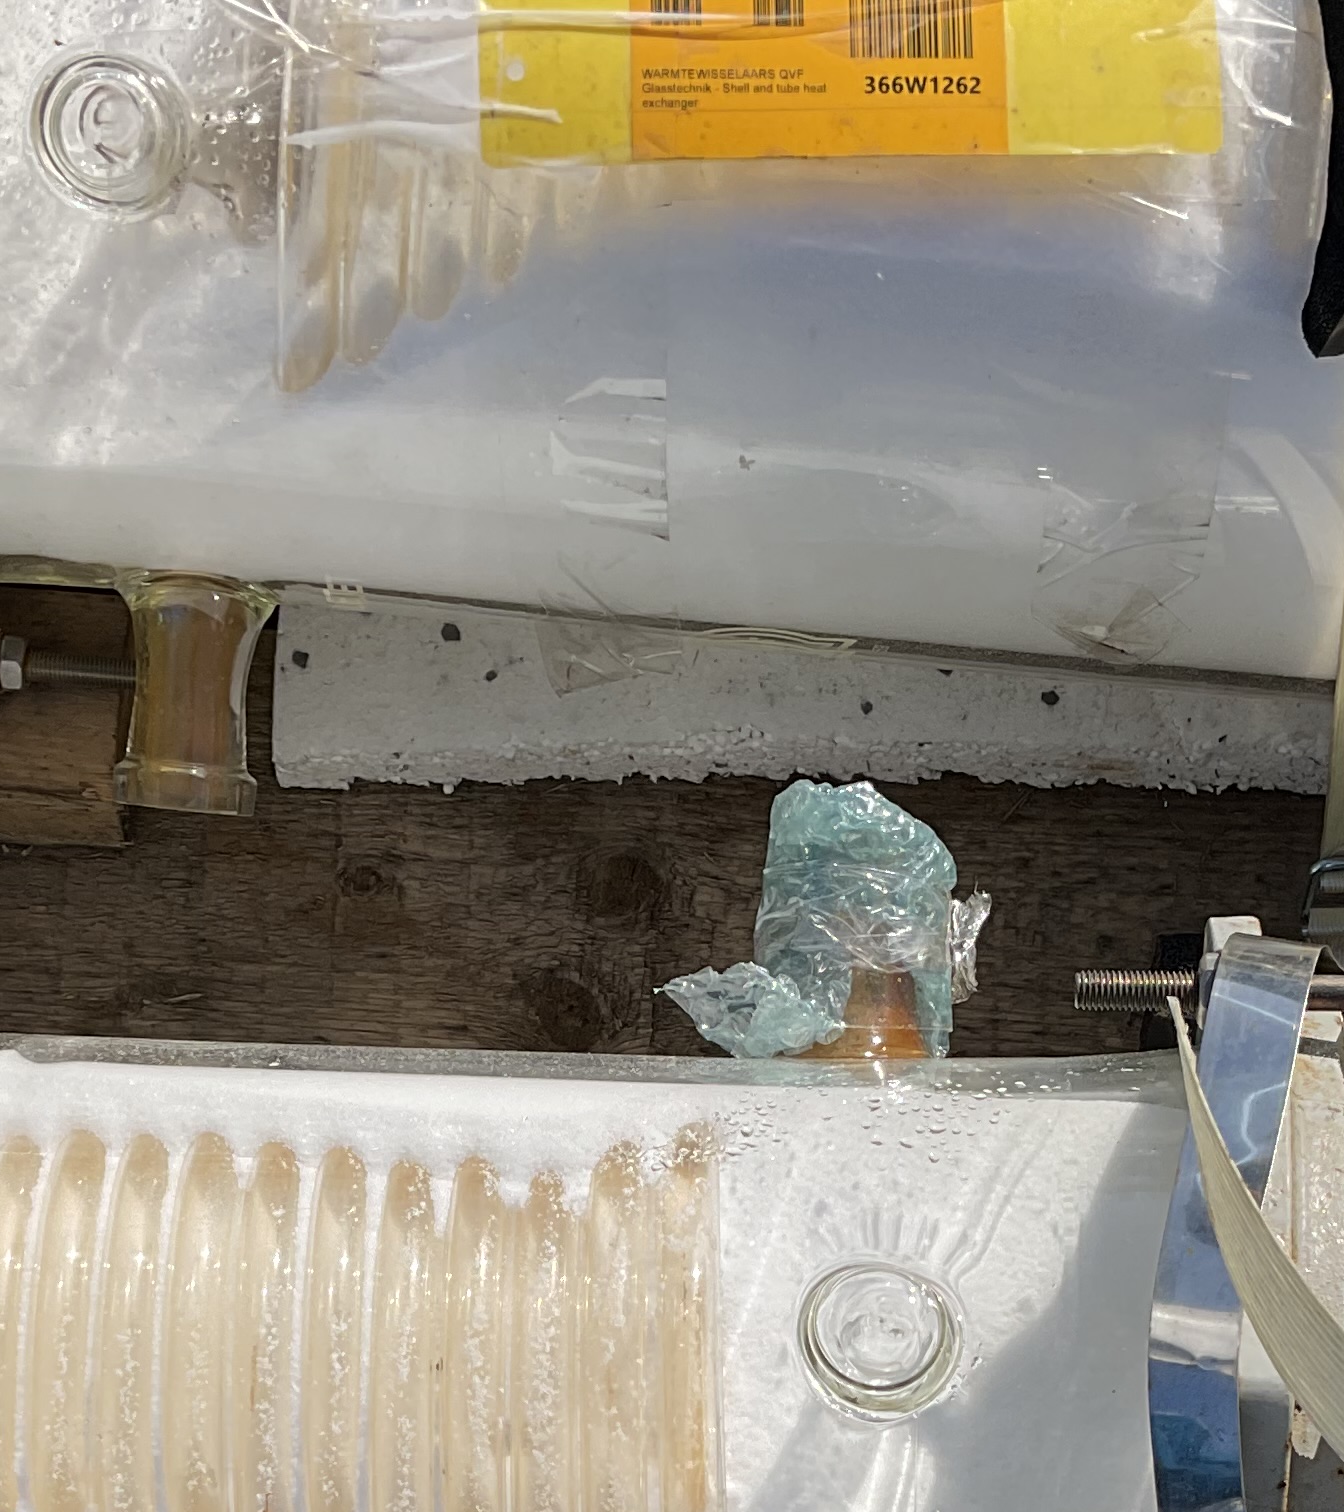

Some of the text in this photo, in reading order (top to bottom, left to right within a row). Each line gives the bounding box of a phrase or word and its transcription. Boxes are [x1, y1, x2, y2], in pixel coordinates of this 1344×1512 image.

[642, 69, 804, 80] WARMTEWISSELAARS QVF
[642, 83, 711, 93] Glasstechnik
[723, 83, 750, 93] Shell
[753, 83, 773, 93] and
[776, 83, 800, 93] tube
[804, 83, 827, 93] heat
[864, 75, 981, 94] 366W1262
[642, 97, 698, 110] exchanger
